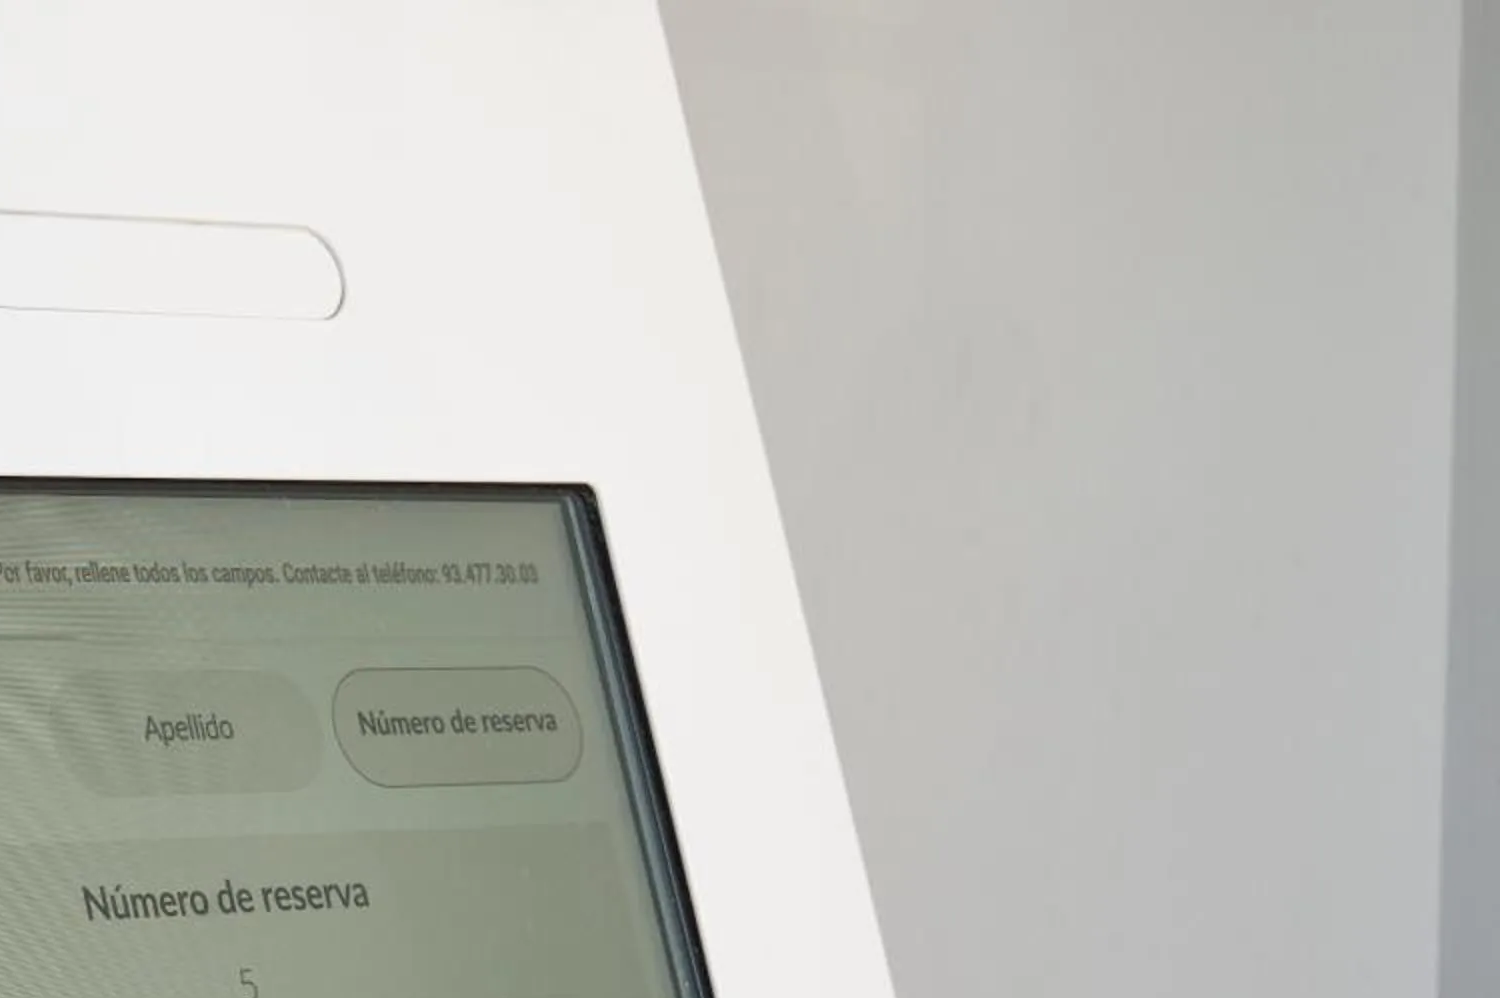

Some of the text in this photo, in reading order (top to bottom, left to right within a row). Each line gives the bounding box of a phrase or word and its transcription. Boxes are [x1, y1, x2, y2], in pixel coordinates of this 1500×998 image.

[24, 560, 74, 588] favor,
[74, 561, 131, 584] rellene
[132, 561, 181, 584] todos
[181, 561, 209, 584] los
[211, 562, 280, 589] campos.
[281, 561, 353, 585] Contacte
[356, 562, 371, 584] al
[371, 560, 438, 585] teléfono:
[144, 711, 235, 747] Apellido
[356, 707, 558, 737] Número de reserva
[81, 879, 371, 922] Número de reserva
